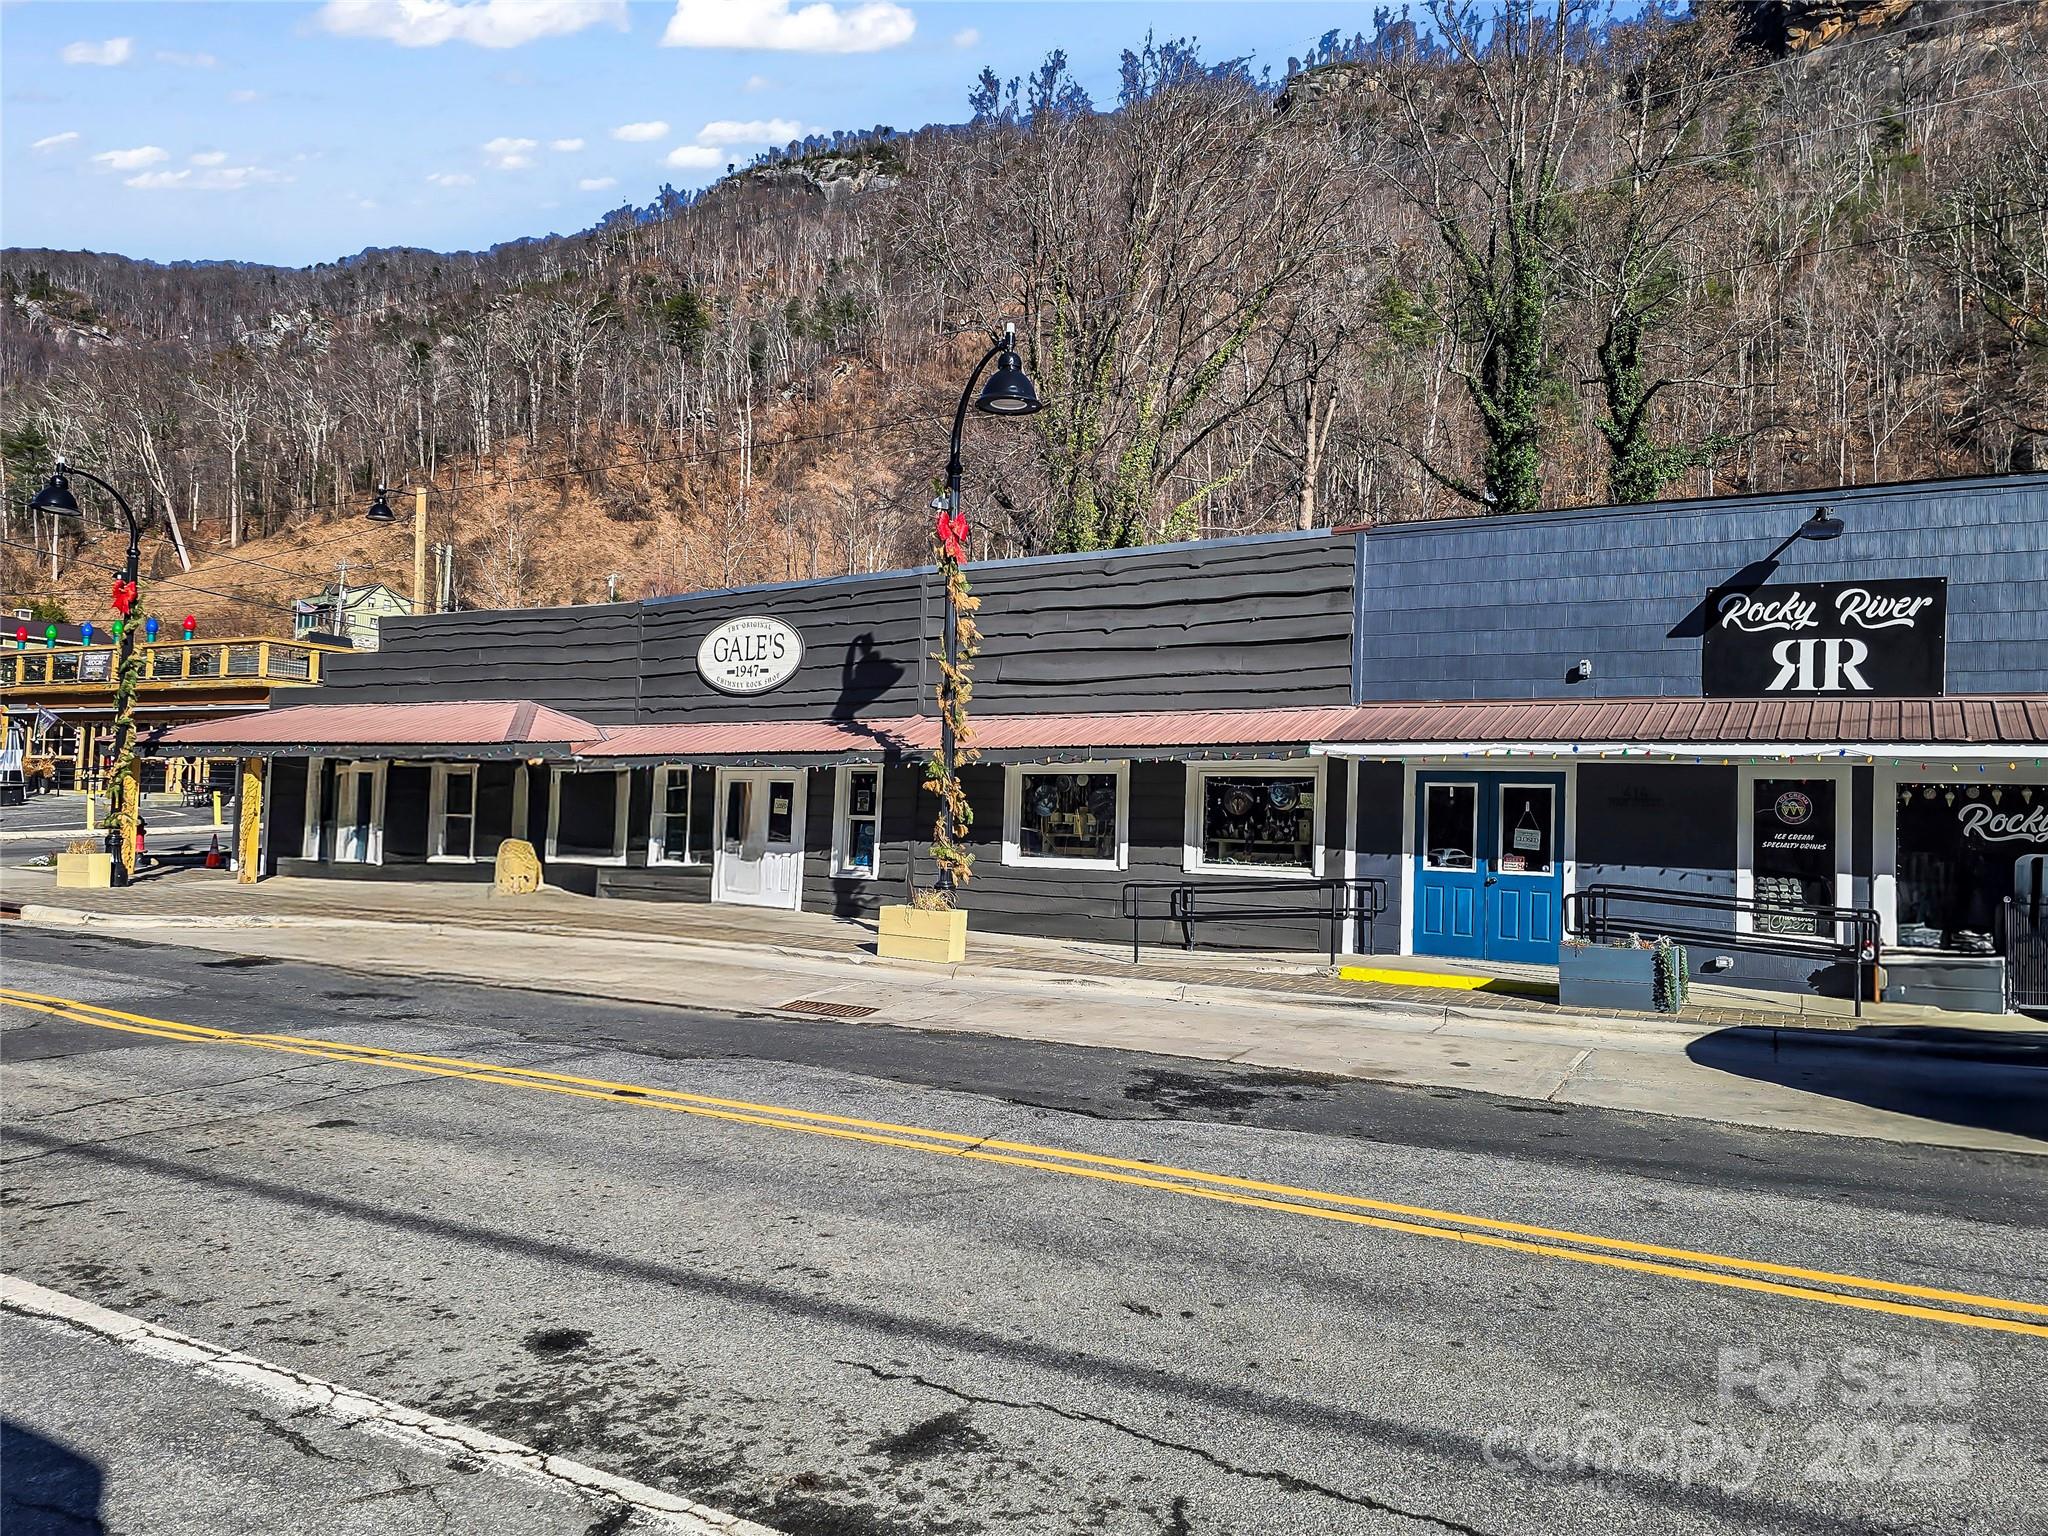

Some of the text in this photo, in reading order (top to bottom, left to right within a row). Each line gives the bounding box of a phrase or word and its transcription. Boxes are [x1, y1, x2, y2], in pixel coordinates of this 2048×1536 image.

[1717, 588, 1934, 632] Rocky River
[728, 622, 771, 633] THE ORIGINAL
[713, 633, 785, 662] GALE'S
[735, 664, 759, 677] 1947
[716, 676, 744, 688] CHIMNEY
[745, 680, 762, 688] ROCK
[1761, 841, 1799, 849] SPECIALTY
[1770, 915, 1815, 933] Open
